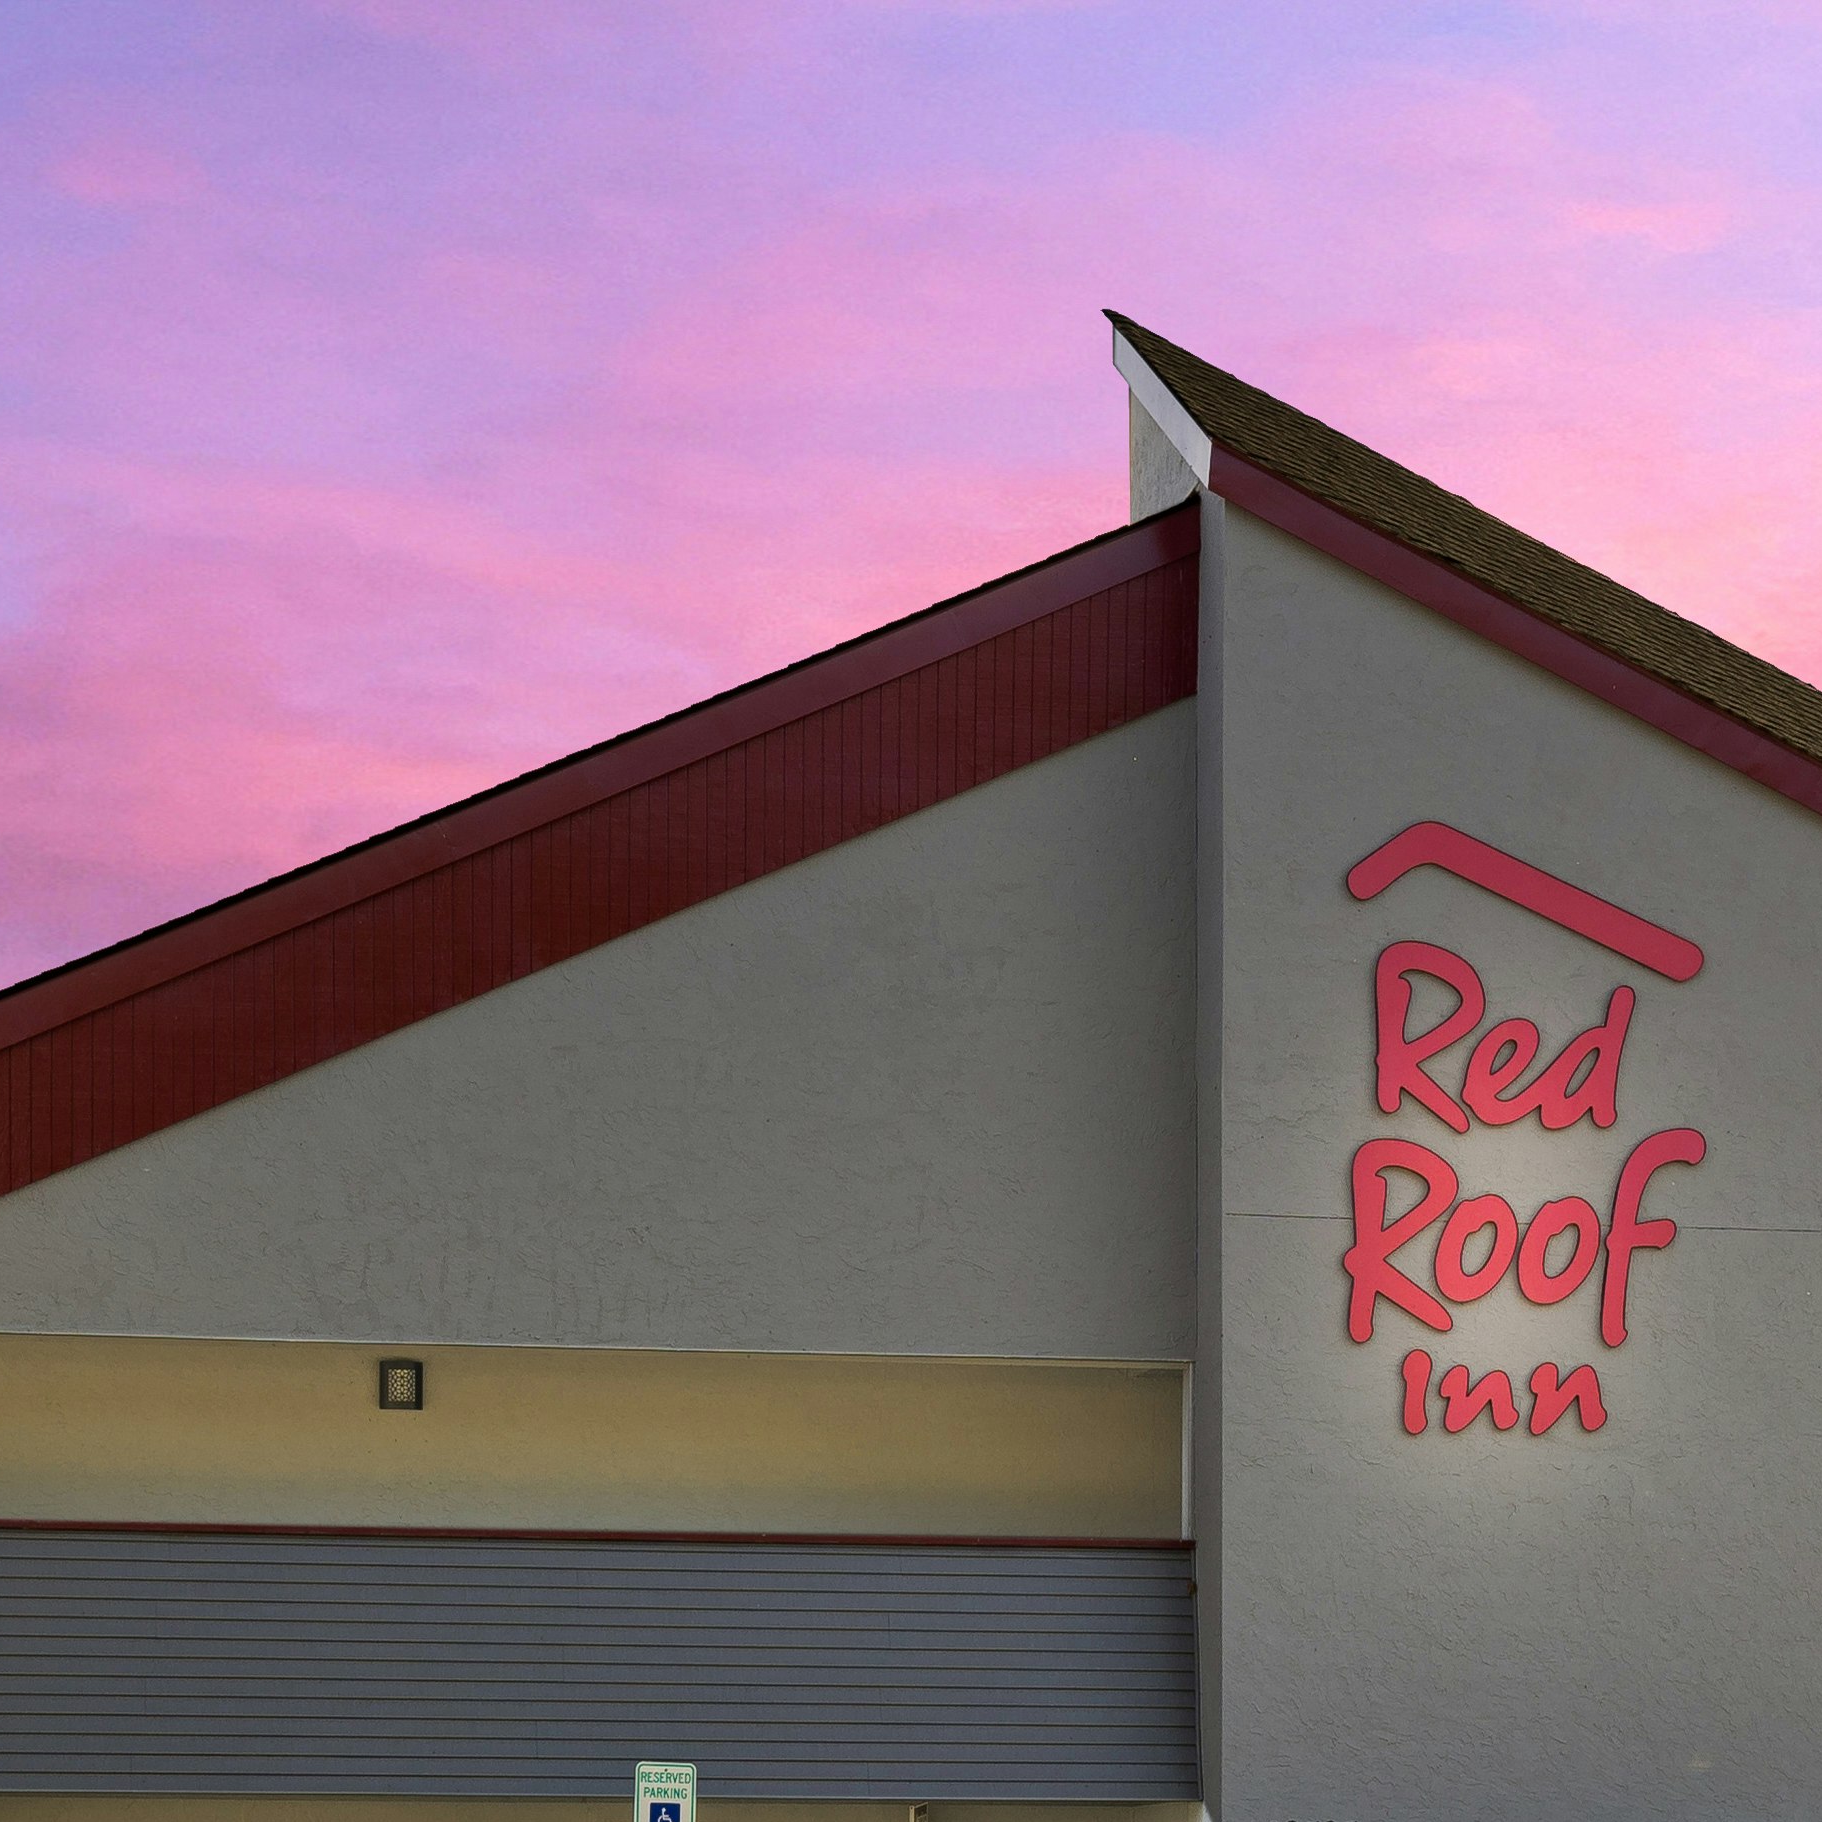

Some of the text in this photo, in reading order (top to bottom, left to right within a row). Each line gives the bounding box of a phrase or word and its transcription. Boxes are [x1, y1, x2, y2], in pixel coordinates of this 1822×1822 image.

[1375, 940, 1636, 1134] Red
[1343, 1127, 1707, 1348] Roof
[1401, 1348, 1608, 1435] Inn
[640, 1771, 691, 1784] RESERVED
[643, 1786, 688, 1800] PARKING
